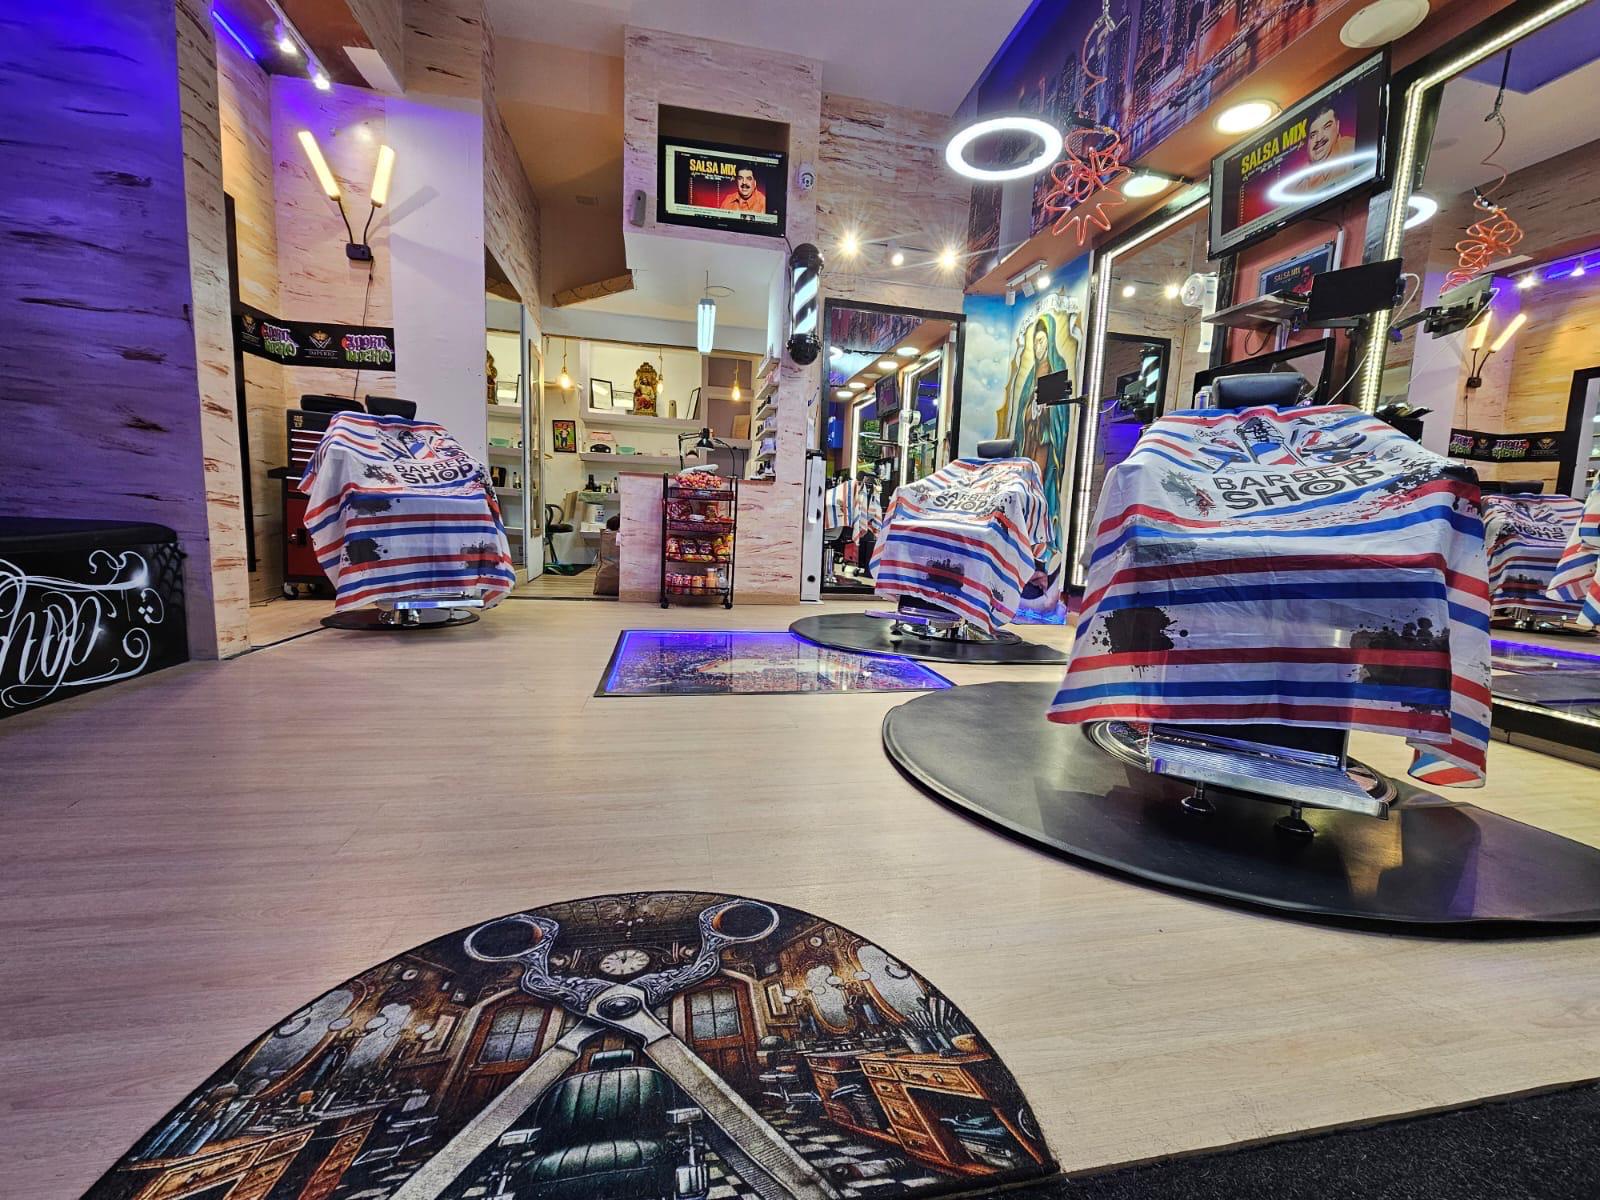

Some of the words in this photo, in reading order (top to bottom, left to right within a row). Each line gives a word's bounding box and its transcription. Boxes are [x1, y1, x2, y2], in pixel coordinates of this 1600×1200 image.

[1241, 137, 1279, 175] SALSA
[1282, 118, 1308, 151] MIX
[689, 159, 719, 174] SALSA
[720, 163, 737, 177] MIX
[393, 456, 468, 474] BARBER
[400, 462, 474, 484] SHOP
[1213, 458, 1372, 491] BARBER
[943, 490, 991, 501] ARBE
[1222, 469, 1385, 510] SHOP
[932, 495, 988, 511] SHOP
